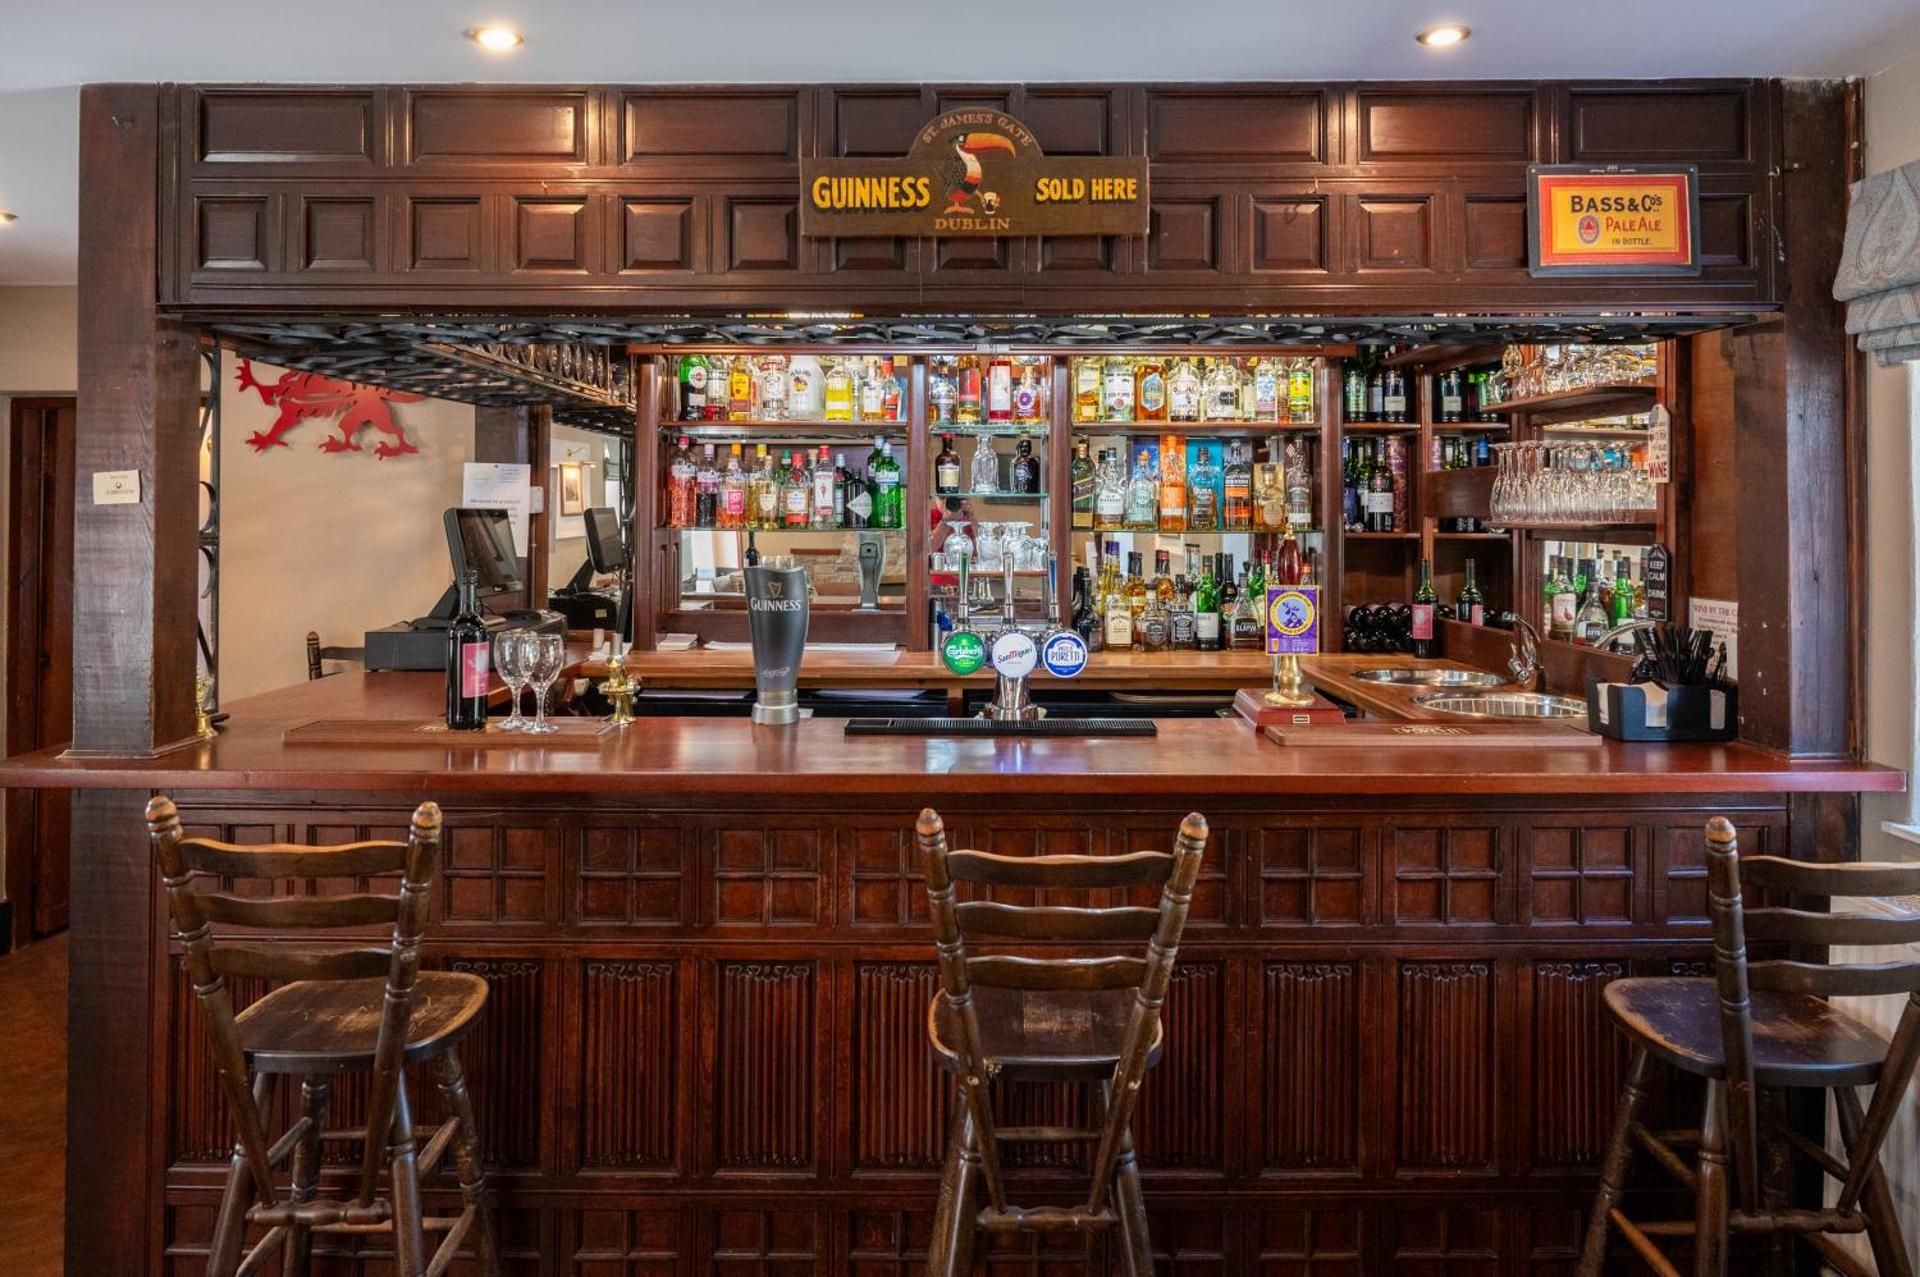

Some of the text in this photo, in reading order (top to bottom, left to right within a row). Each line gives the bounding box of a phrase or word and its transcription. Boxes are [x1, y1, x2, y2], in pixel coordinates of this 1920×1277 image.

[997, 117, 1032, 146] GATE
[812, 176, 1137, 209] GUINNESS SOLD HERE
[934, 218, 1011, 231] DUBLIN
[1606, 217, 1661, 232] PALE ALE
[1623, 237, 1650, 245] BOTTLE
[1649, 462, 1667, 478] WINE
[1650, 561, 1664, 569] KEEP
[1649, 572, 1664, 580] CALM
[750, 596, 802, 612] GUINNESS
[1718, 607, 1730, 615] THE
[946, 645, 984, 658] Carlsberg
[1051, 651, 1080, 662] PORETTI
